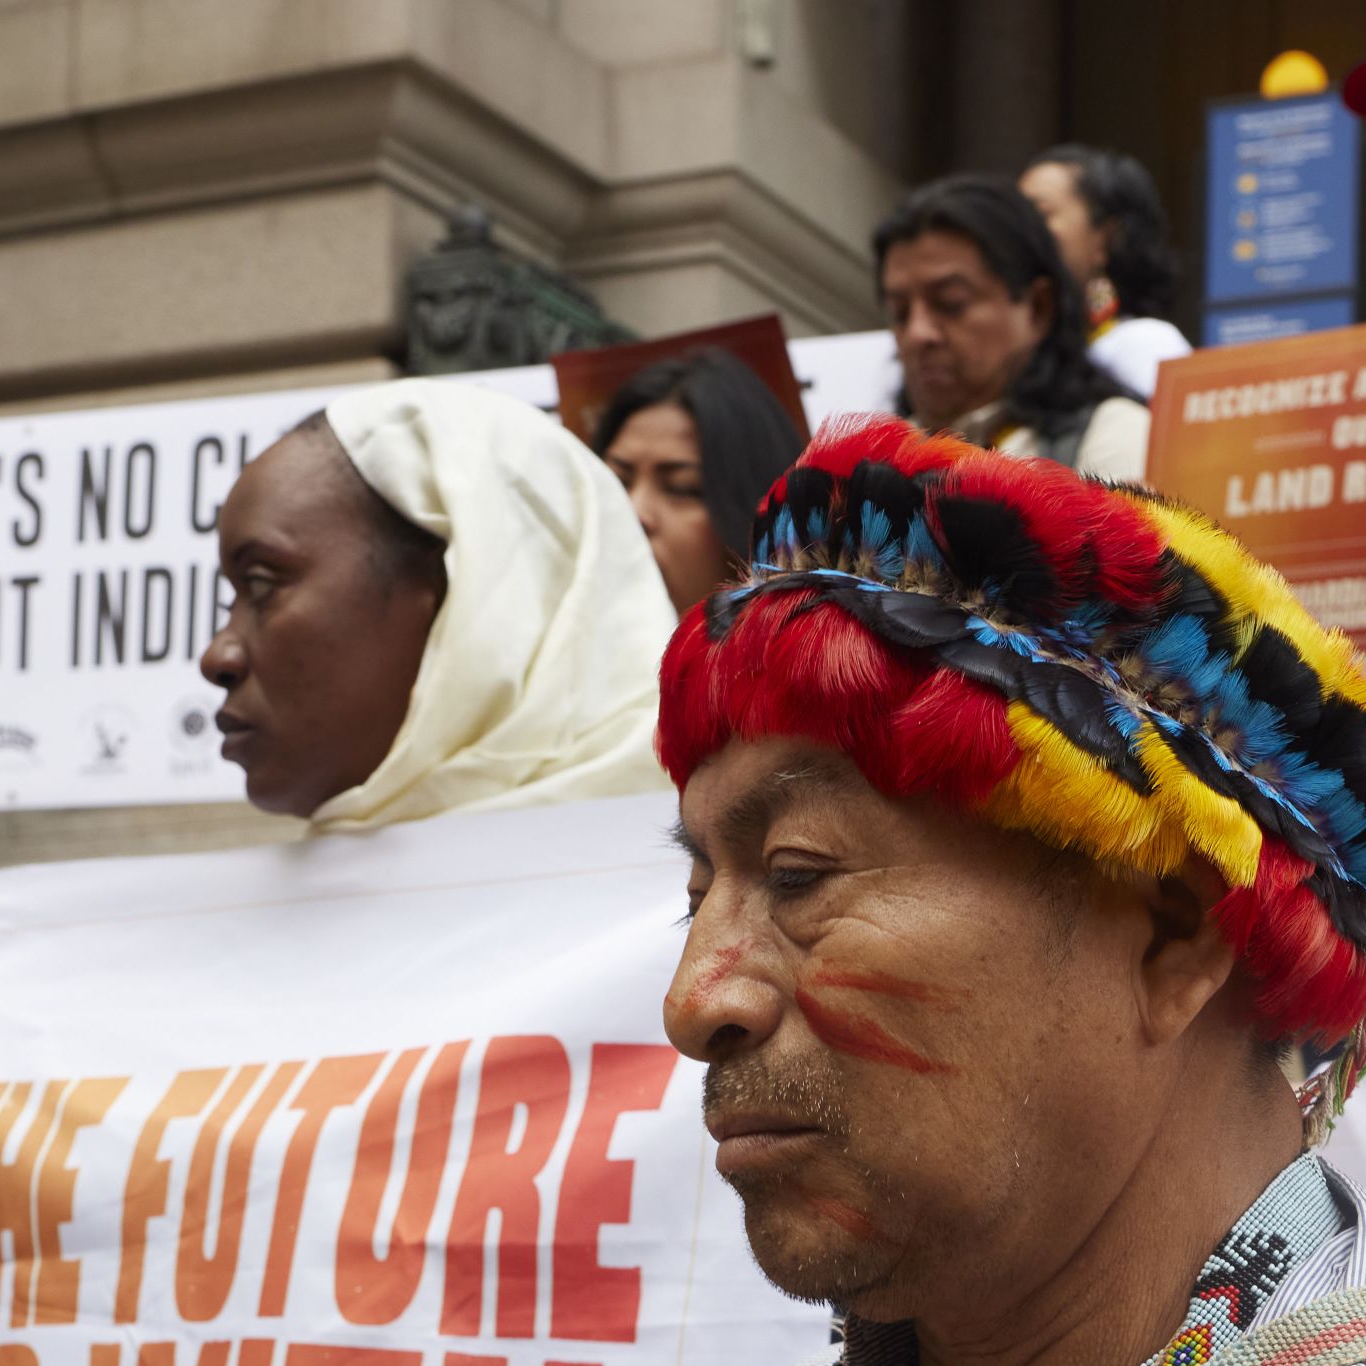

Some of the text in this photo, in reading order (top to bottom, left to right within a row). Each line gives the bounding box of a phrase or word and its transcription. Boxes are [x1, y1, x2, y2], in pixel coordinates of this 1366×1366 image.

[1182, 370, 1348, 423] RECOGNIZE
[77, 442, 156, 544] NO
[1225, 463, 1334, 518] LAND
[114, 1034, 681, 1343] FUTURE
